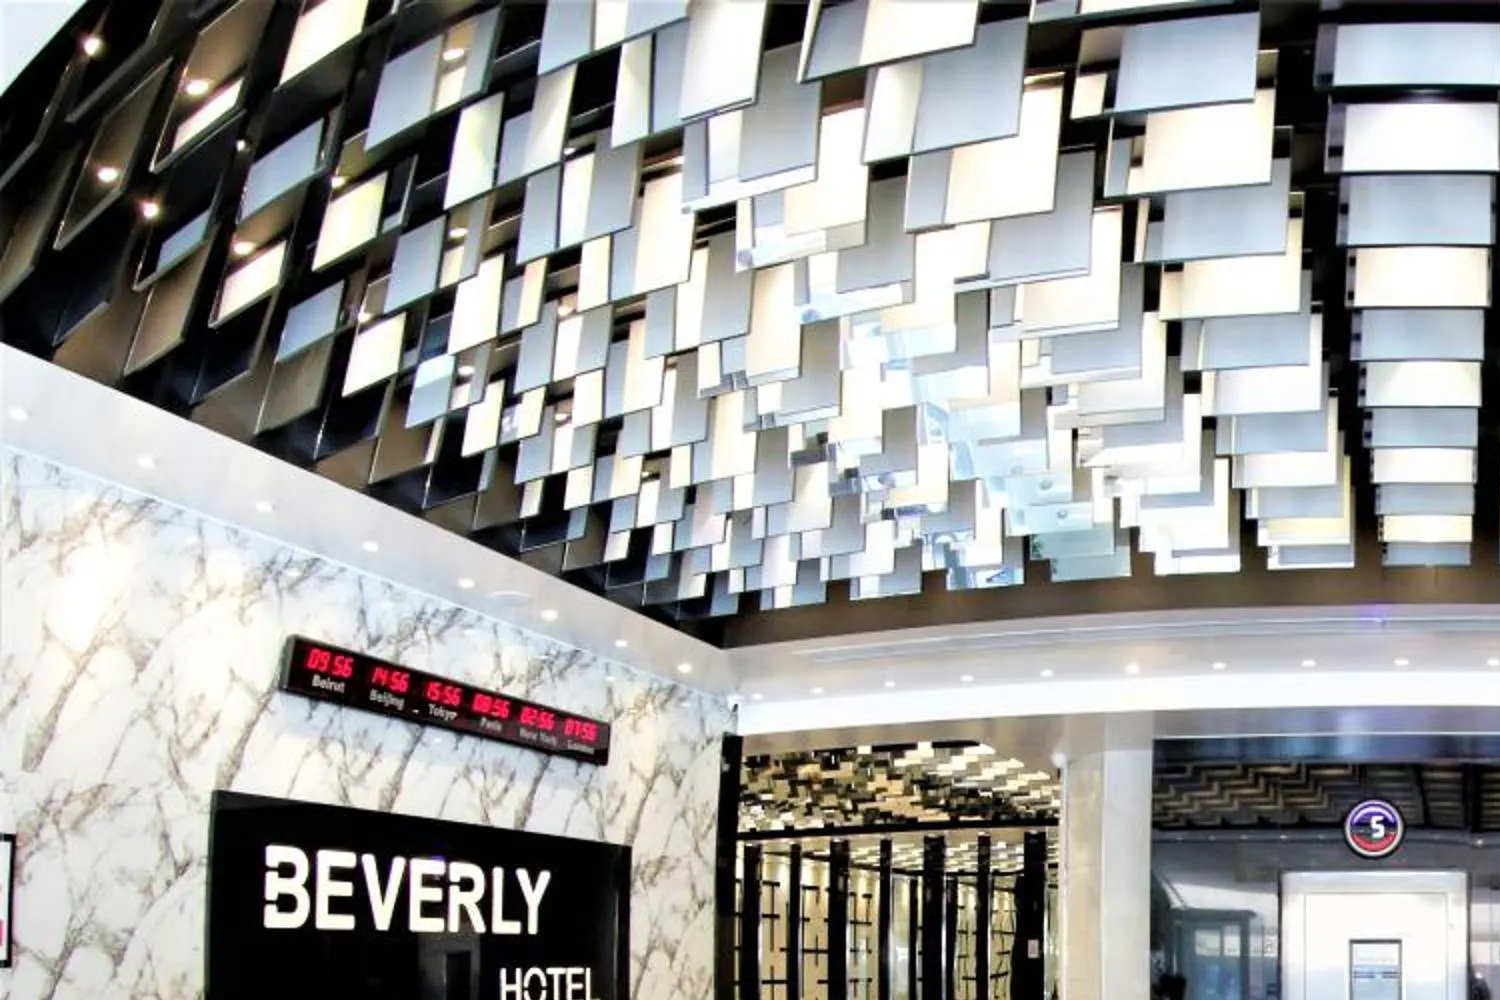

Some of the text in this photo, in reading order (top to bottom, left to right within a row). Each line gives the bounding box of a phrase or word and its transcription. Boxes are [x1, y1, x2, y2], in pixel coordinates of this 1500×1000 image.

[311, 673, 346, 694] Beirut
[428, 703, 458, 721] Tokyo
[263, 844, 551, 935] BEVERLY
